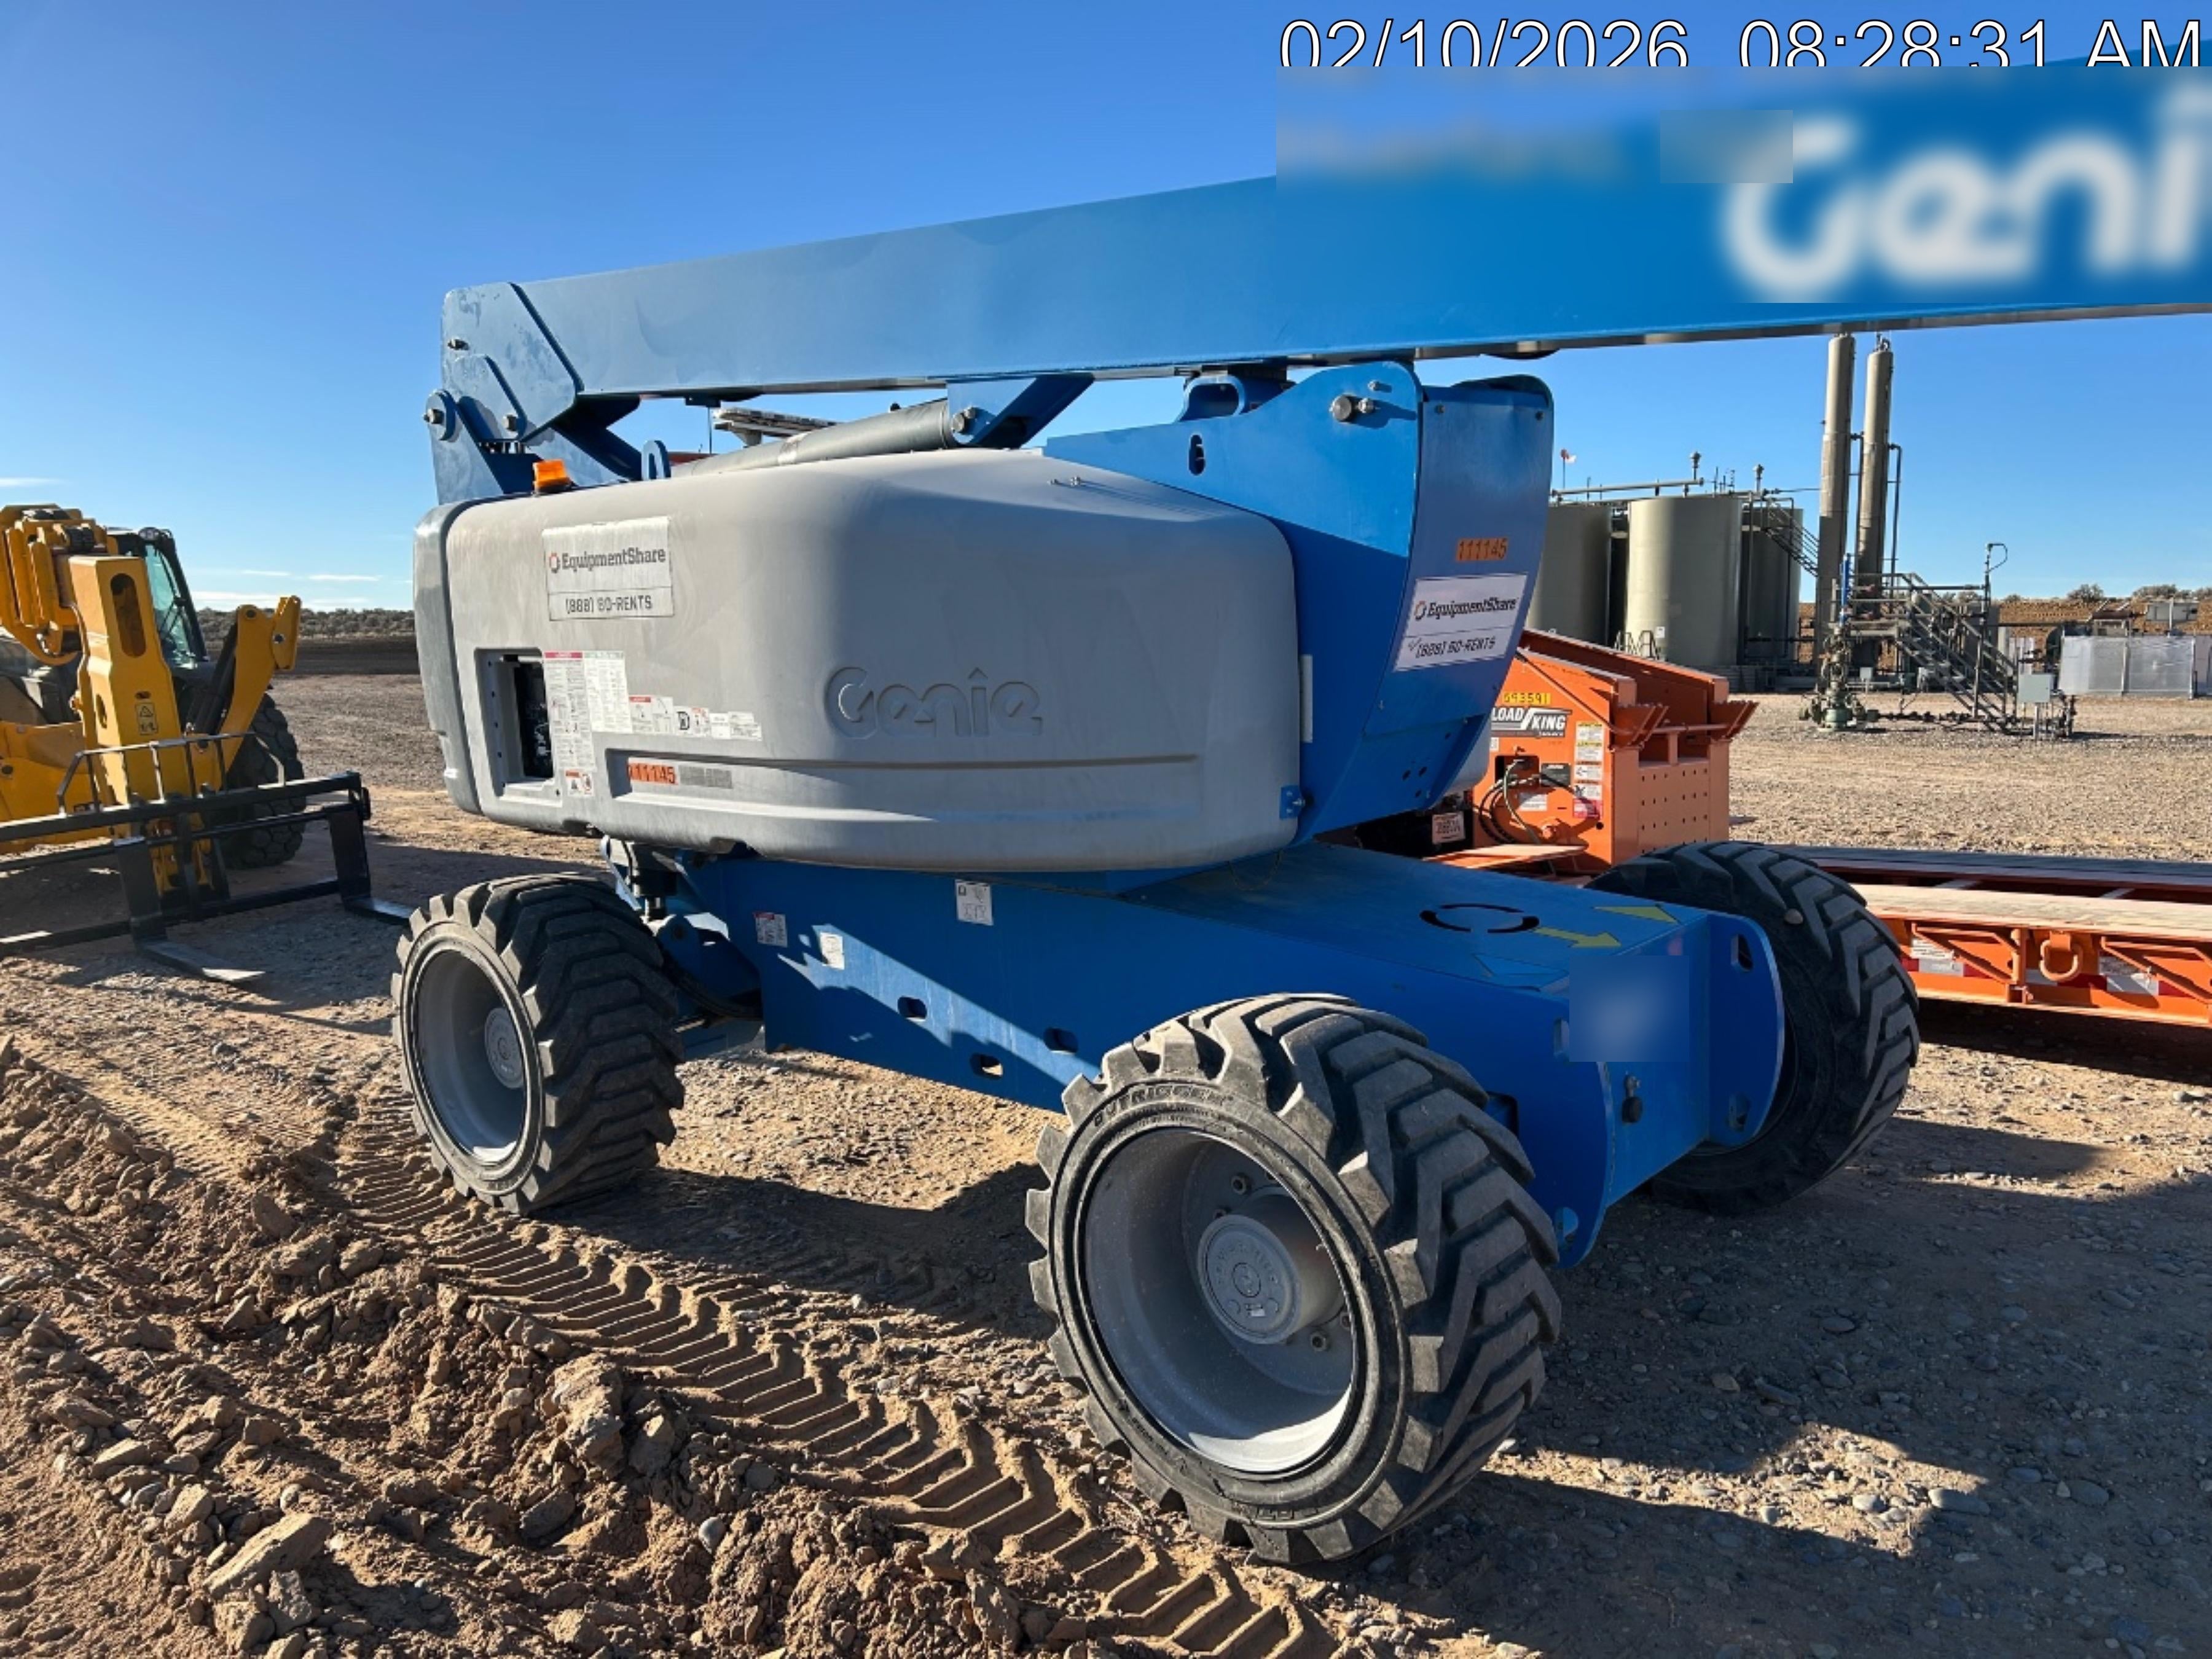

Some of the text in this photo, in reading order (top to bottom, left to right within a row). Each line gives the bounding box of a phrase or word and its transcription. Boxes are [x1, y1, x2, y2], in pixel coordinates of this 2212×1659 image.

[562, 547, 666, 572] EquipmentShare
[1459, 538, 1507, 560] 111145
[1427, 597, 1516, 619] EquipmentShare
[825, 667, 1043, 739] Genie
[1490, 707, 1566, 731] LOAD KING
